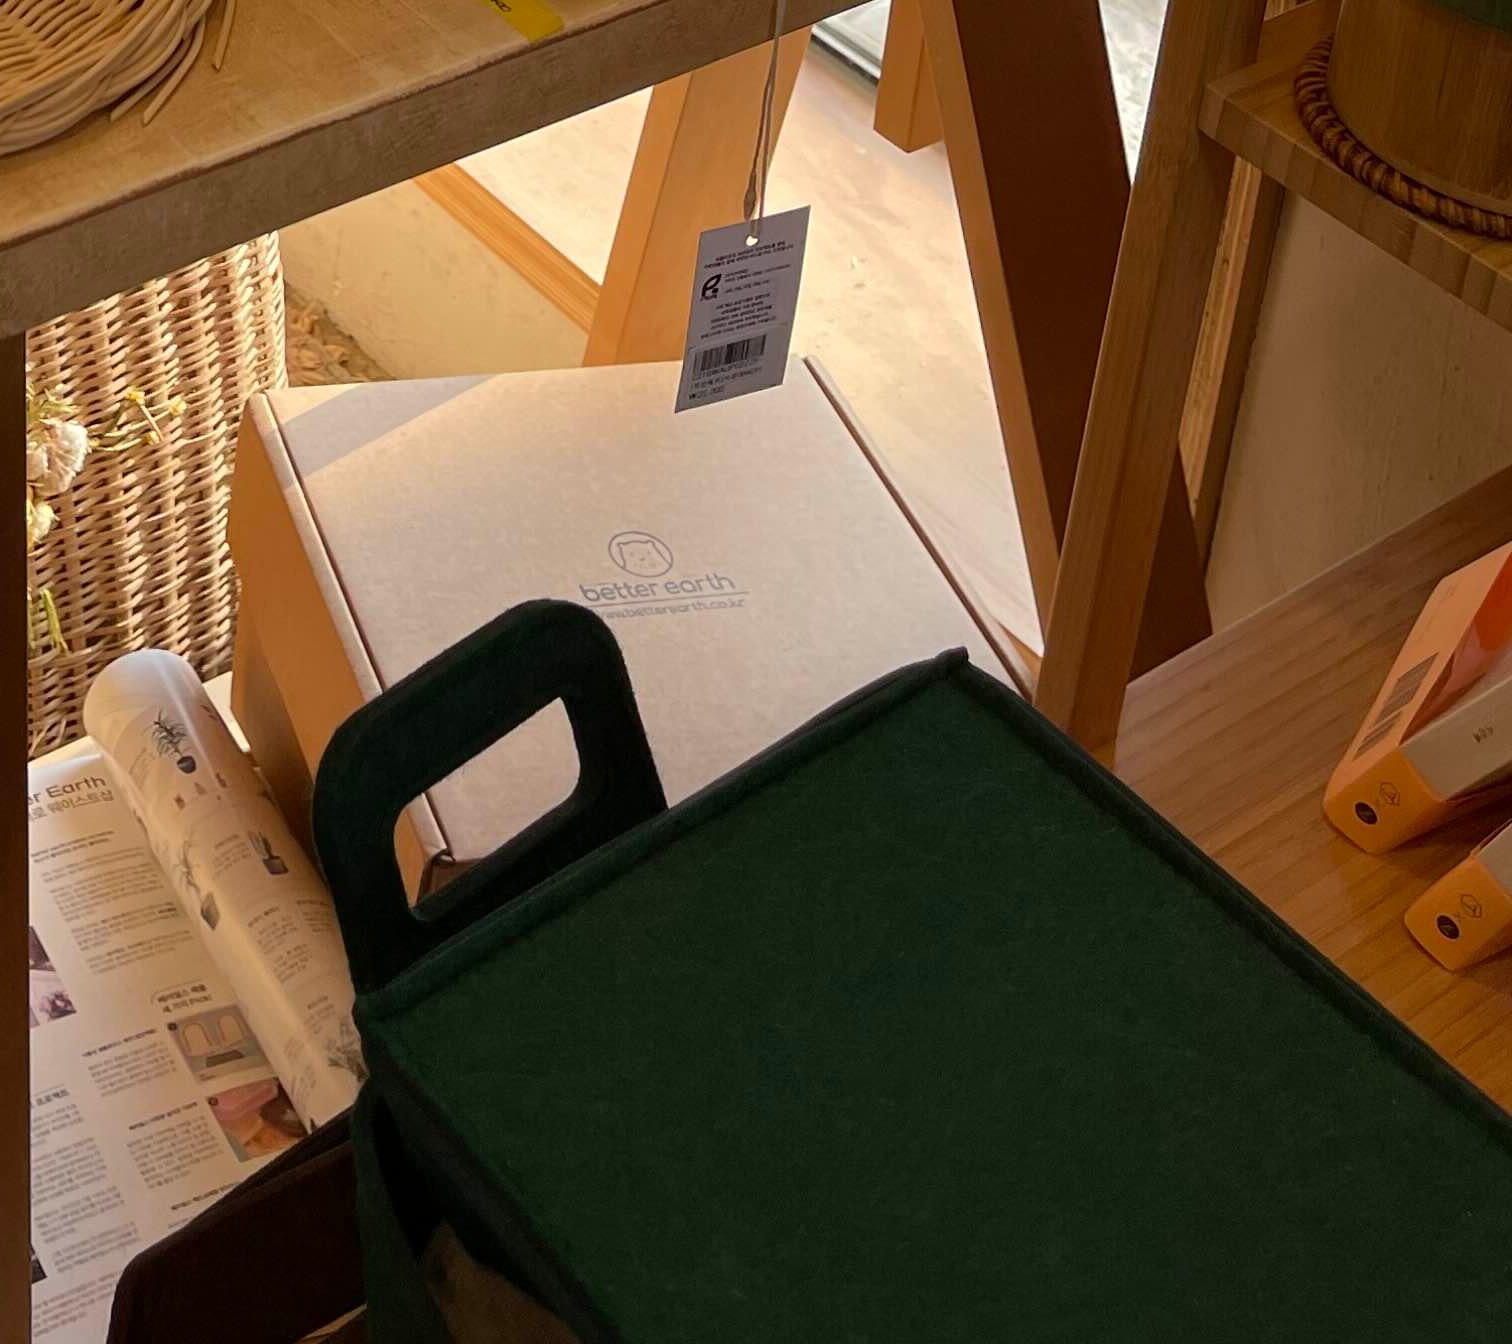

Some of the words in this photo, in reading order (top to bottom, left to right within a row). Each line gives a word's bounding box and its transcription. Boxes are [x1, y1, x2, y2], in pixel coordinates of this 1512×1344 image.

[578, 582, 660, 603] better
[663, 571, 737, 595] earth
[46, 774, 107, 798] Earth
